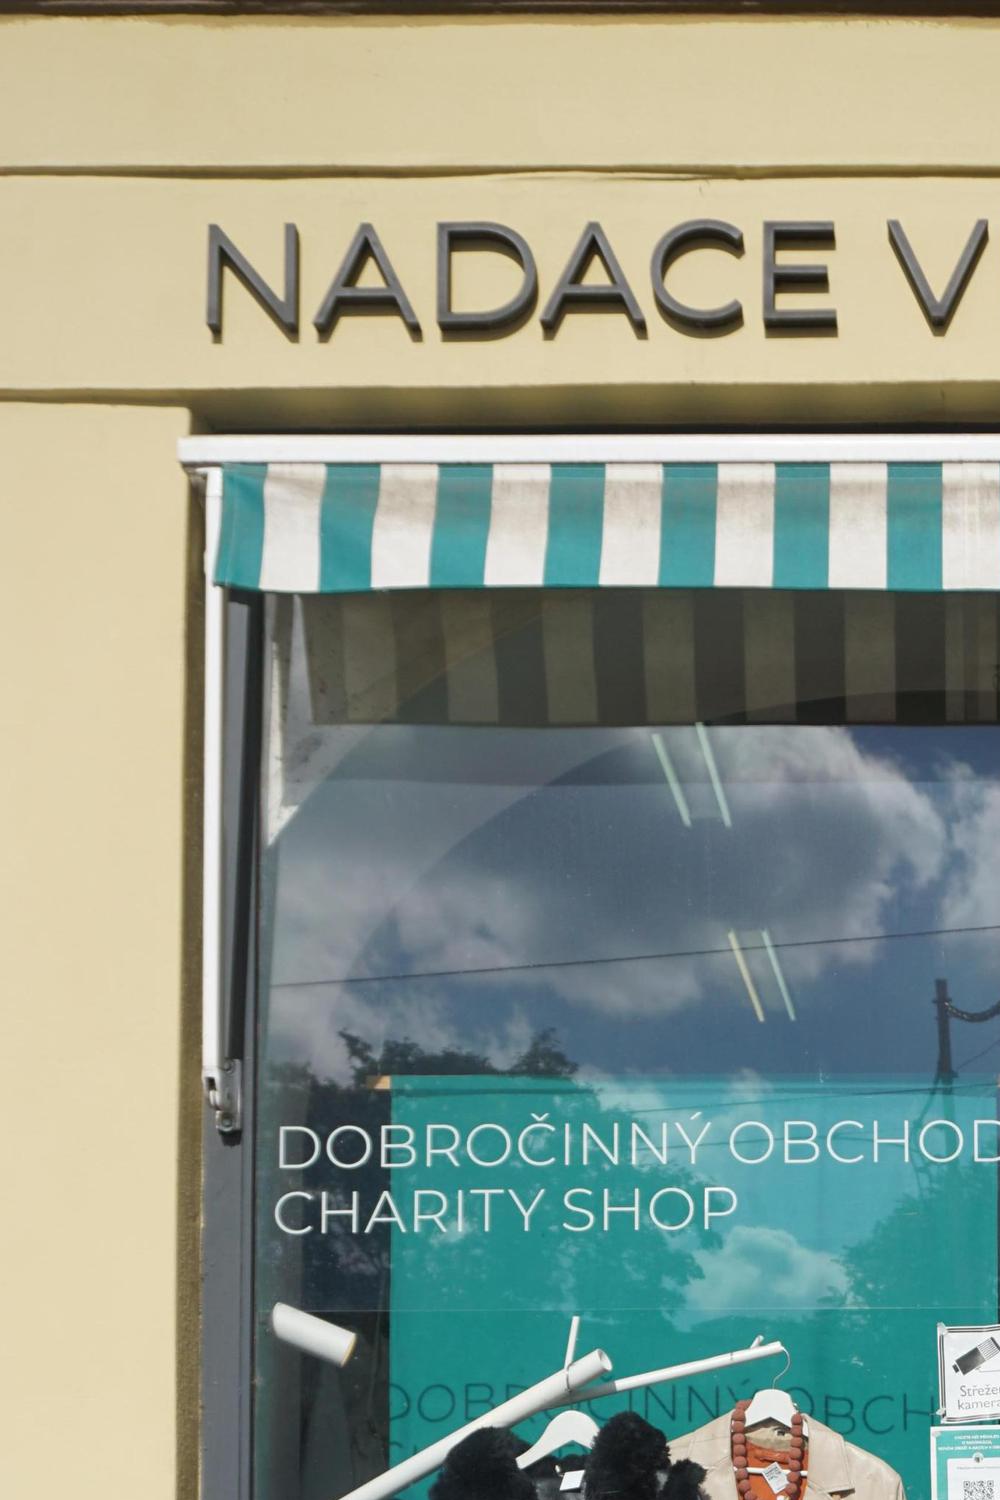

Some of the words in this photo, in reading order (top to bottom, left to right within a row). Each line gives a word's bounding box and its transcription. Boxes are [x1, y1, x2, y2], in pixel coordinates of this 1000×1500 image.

[205, 219, 838, 341] NADACE
[278, 1112, 712, 1170] DOBROČINNÝ
[273, 1186, 546, 1235] CHARITY
[562, 1185, 739, 1232] SHOP
